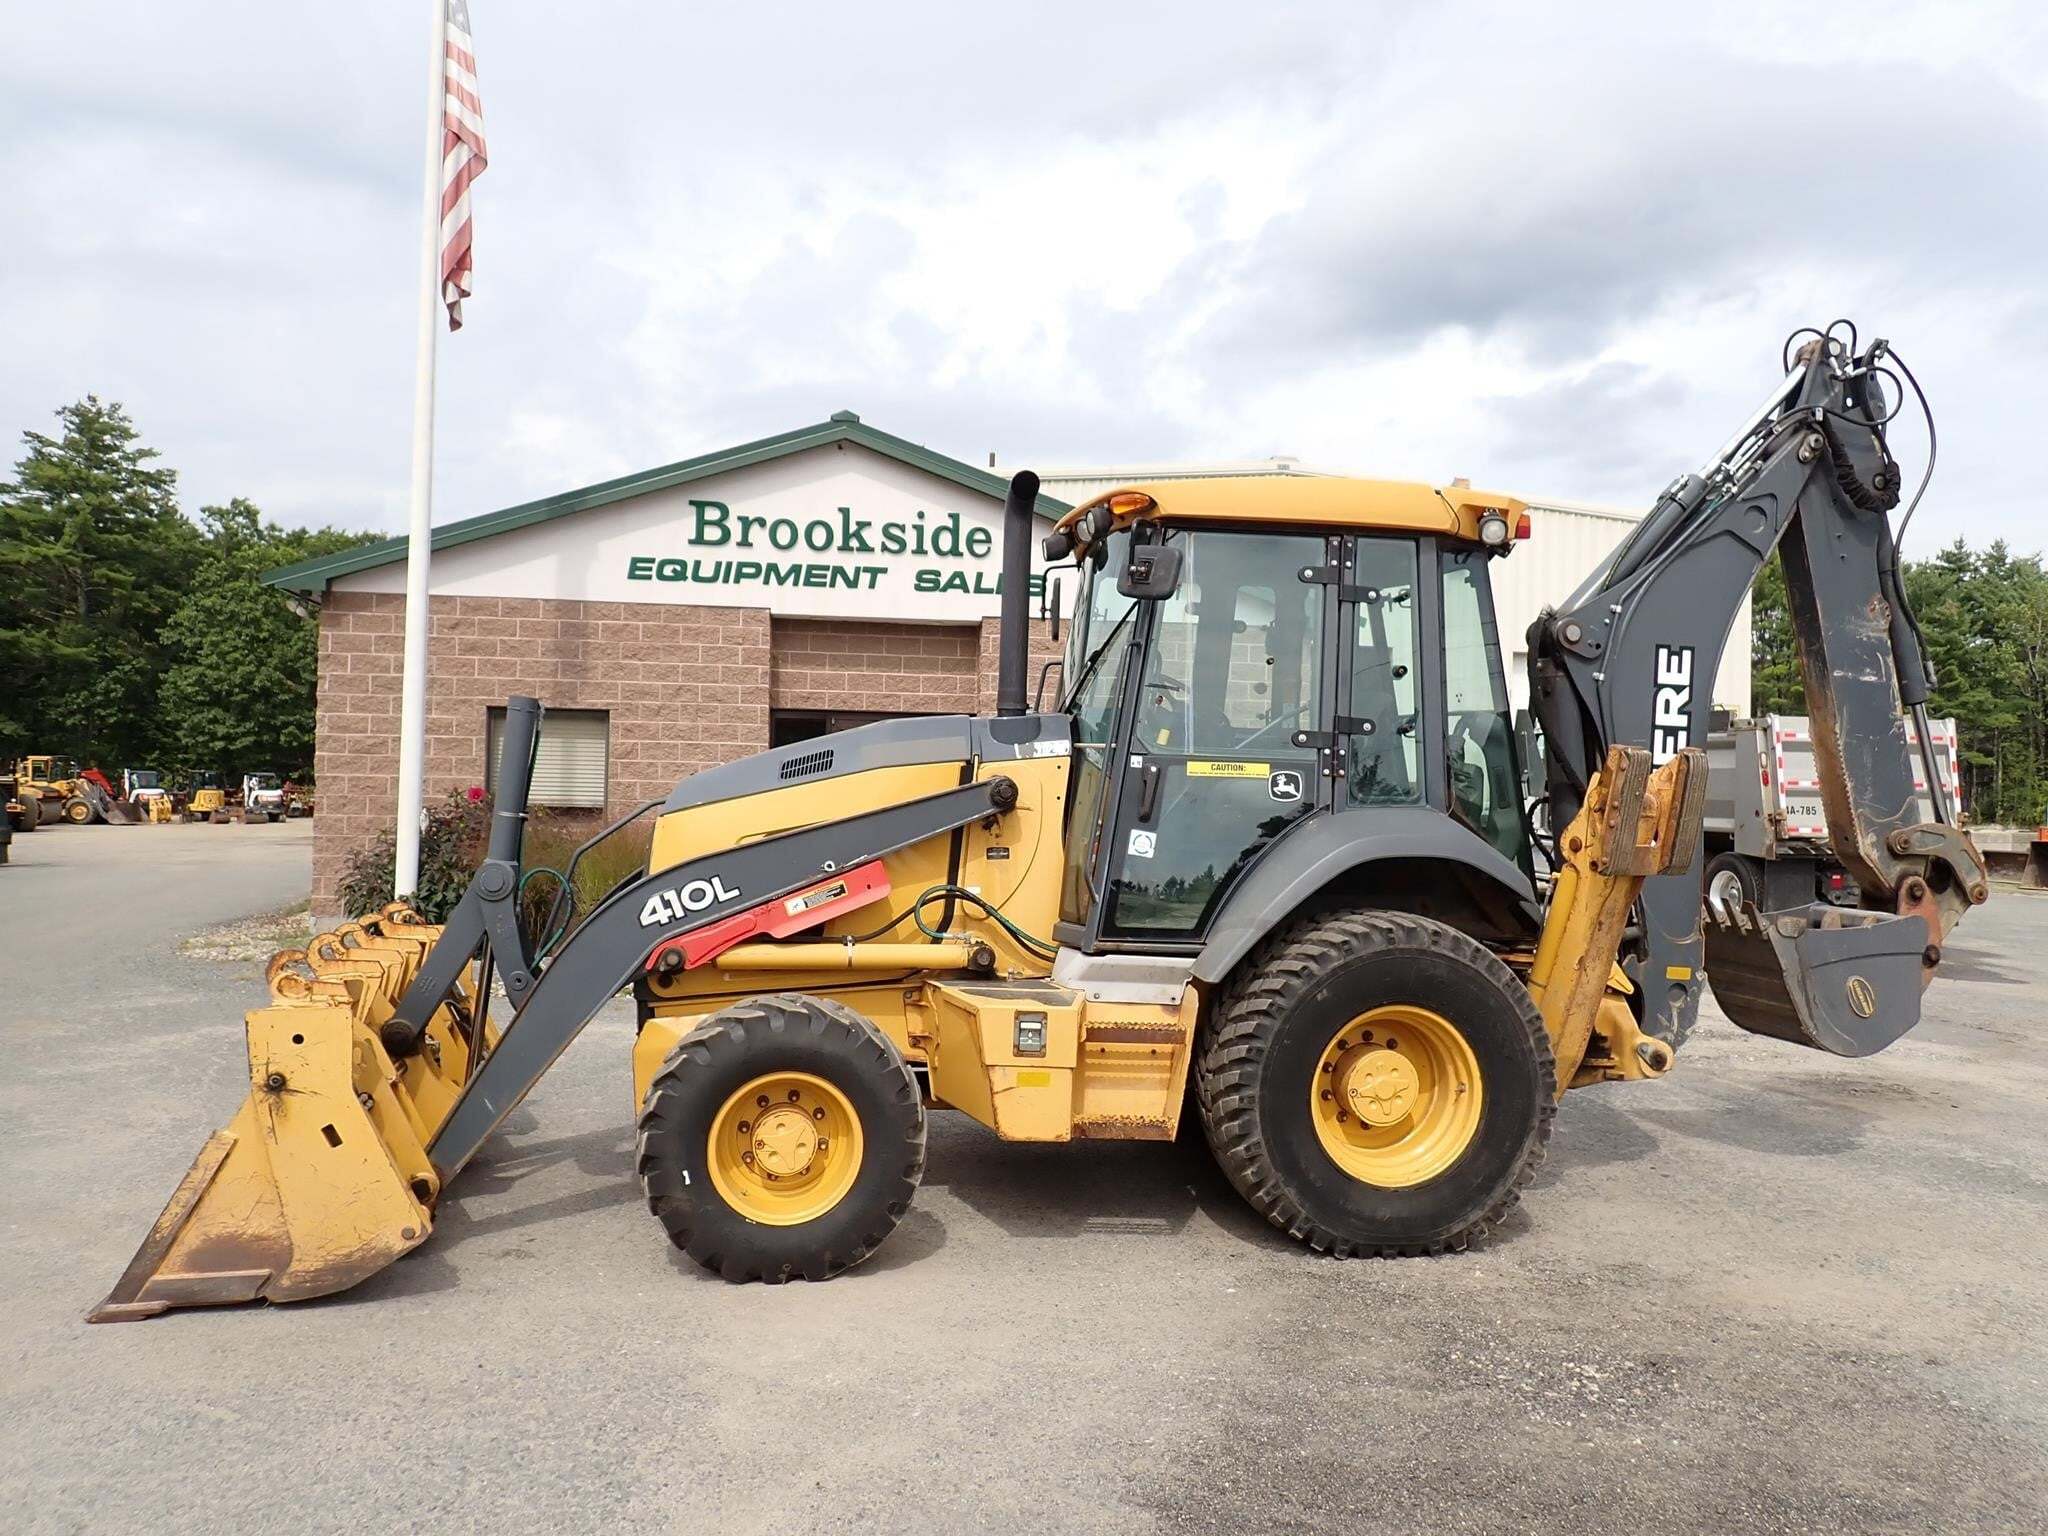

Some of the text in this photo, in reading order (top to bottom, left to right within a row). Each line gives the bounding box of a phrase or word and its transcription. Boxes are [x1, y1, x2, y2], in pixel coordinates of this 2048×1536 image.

[687, 499, 992, 558] Brookside
[627, 556, 888, 590] EQUIPMENT
[1210, 763, 1246, 772] CAUTION:
[640, 877, 740, 926] 410L
